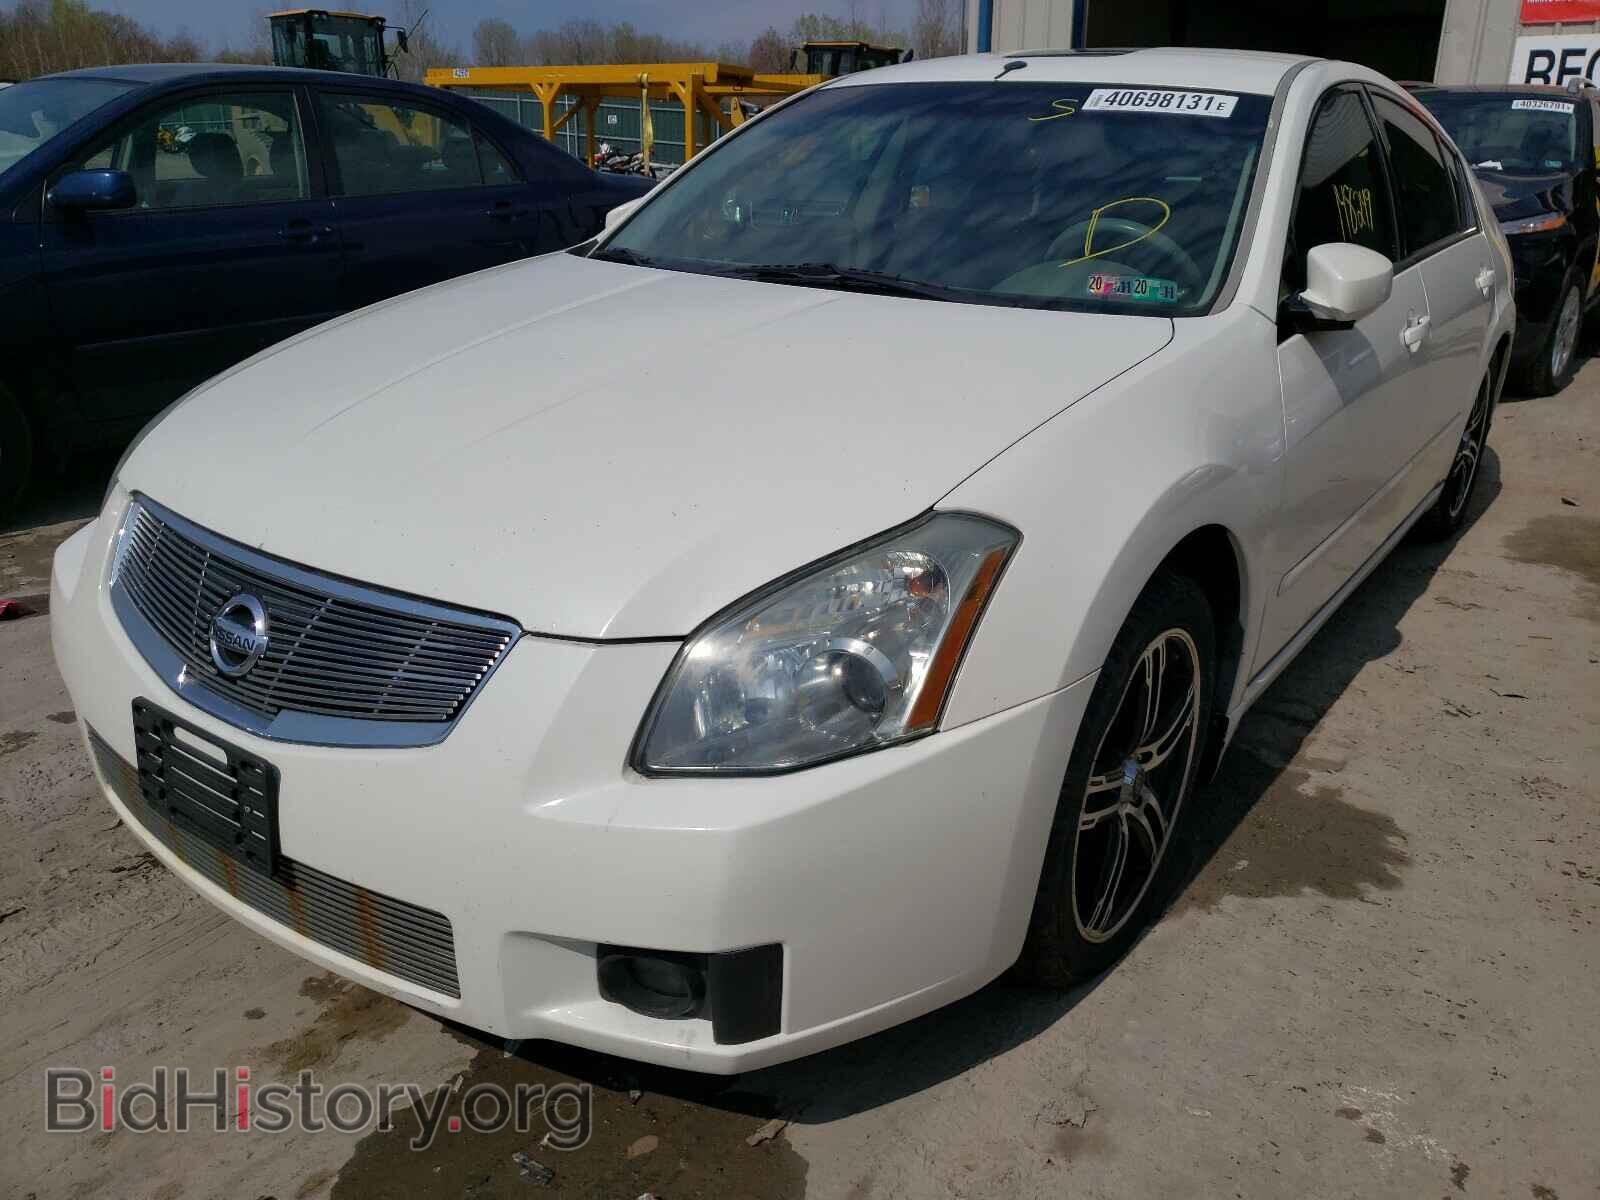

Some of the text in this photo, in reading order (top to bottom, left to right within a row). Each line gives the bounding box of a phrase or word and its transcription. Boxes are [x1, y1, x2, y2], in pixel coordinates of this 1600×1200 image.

[1103, 90, 1215, 111] 40698131
[1216, 102, 1227, 111] E
[1088, 276, 1103, 291] 20
[1134, 279, 1147, 295] 20
[214, 627, 257, 652] ISSAN
